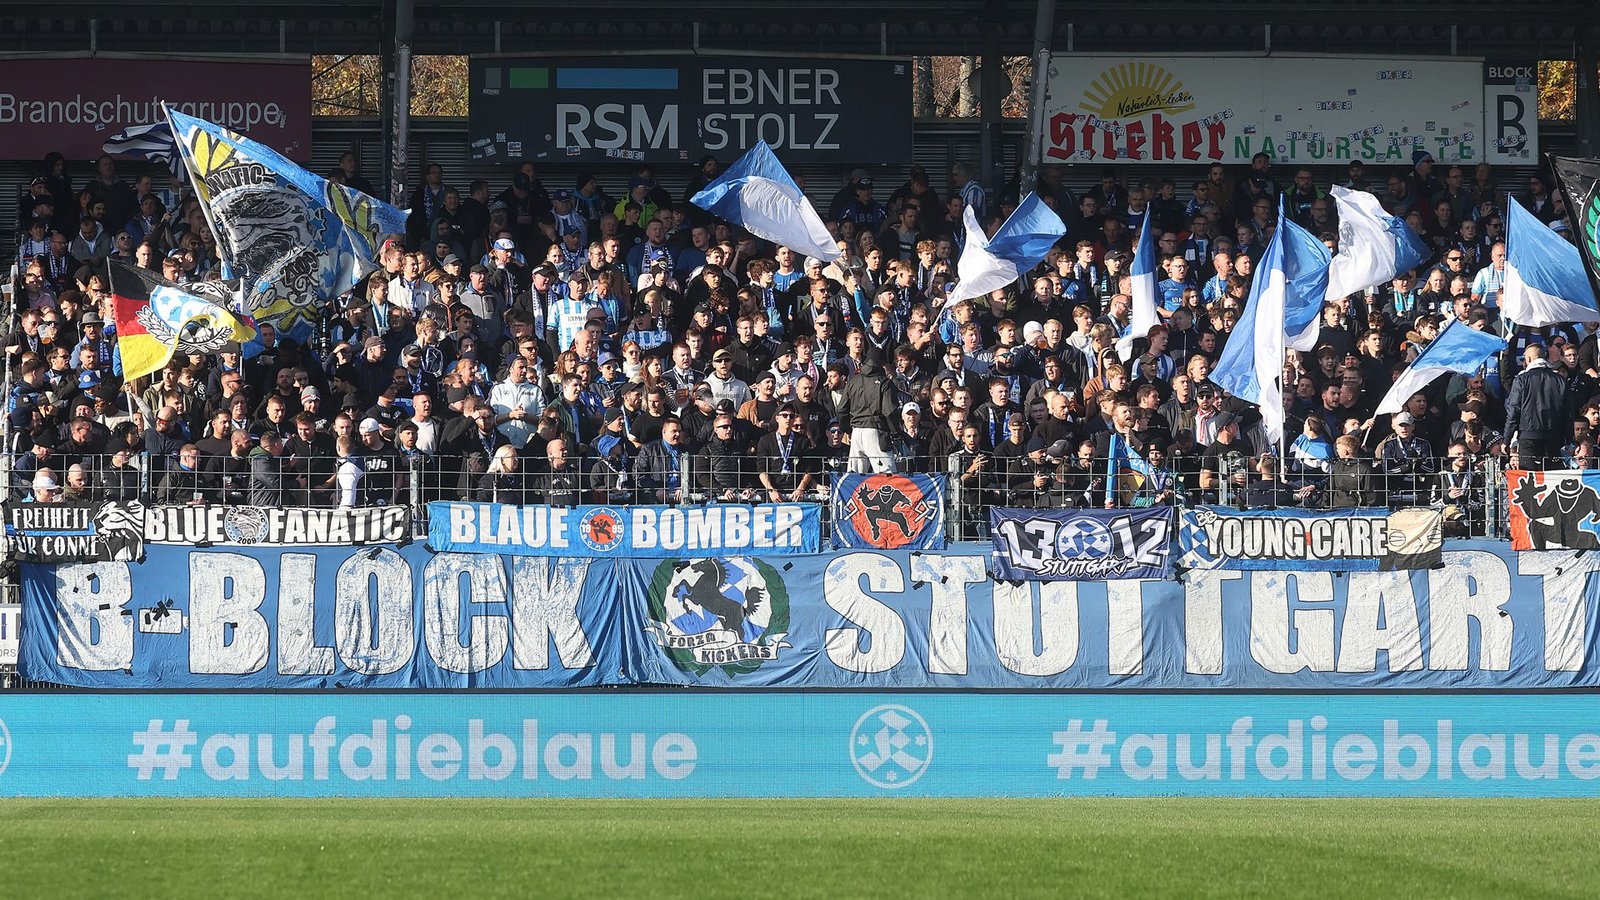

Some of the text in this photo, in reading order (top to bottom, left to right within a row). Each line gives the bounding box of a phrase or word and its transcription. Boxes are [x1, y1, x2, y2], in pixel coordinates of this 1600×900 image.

[703, 68, 841, 105] EBNER
[1488, 66, 1533, 78] BLOCK
[556, 104, 679, 149] RSM
[703, 113, 840, 150] STOLZ
[1497, 95, 1526, 153] B
[12, 507, 91, 529] FREIHEIT
[146, 505, 404, 543] BLUE FANATIC
[450, 506, 803, 549] BLAUE BOMBER
[42, 536, 100, 556] CONNE
[1205, 517, 1389, 559] YOUNG CARE
[1034, 555, 1134, 578] STUTTGART
[56, 548, 1600, 676] B-BLOCK STUTTGART
[669, 632, 716, 647] FORZA
[701, 645, 772, 663] KICKERS
[127, 714, 698, 782] #aufdieblaue
[1047, 714, 1600, 782] #aufdieblaue
